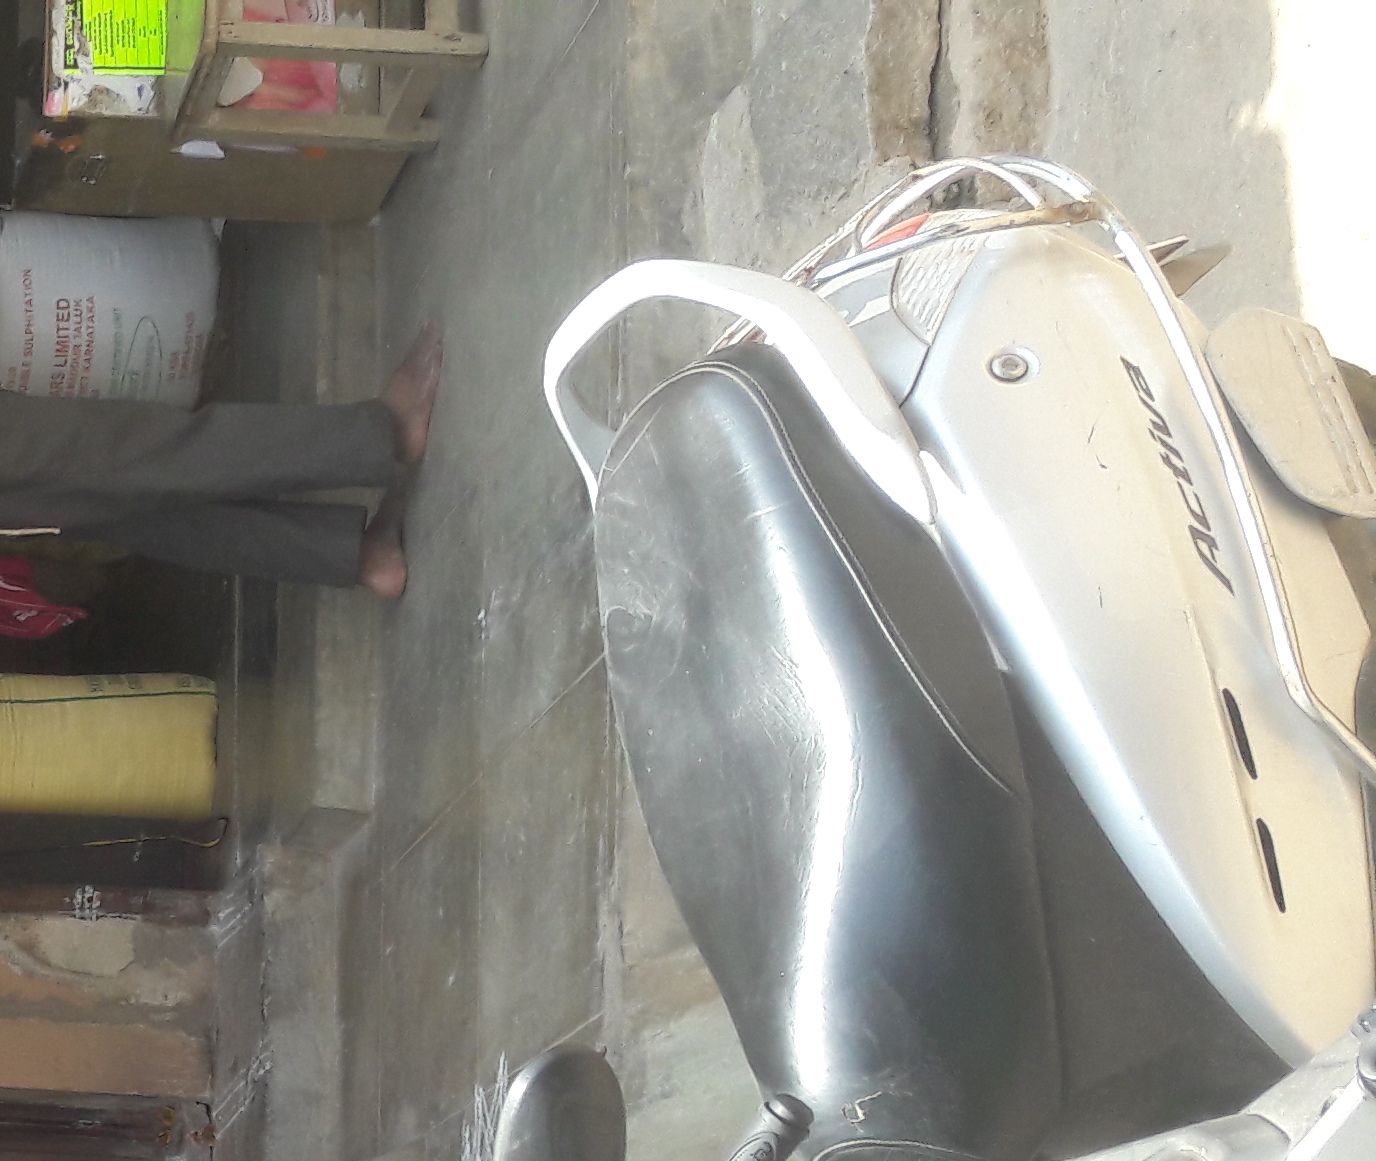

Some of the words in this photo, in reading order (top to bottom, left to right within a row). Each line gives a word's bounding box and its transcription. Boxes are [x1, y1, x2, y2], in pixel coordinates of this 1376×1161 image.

[22, 269, 35, 357] SULPHITATION
[54, 298, 71, 367] LIMITED
[1119, 355, 1235, 597] Activa
